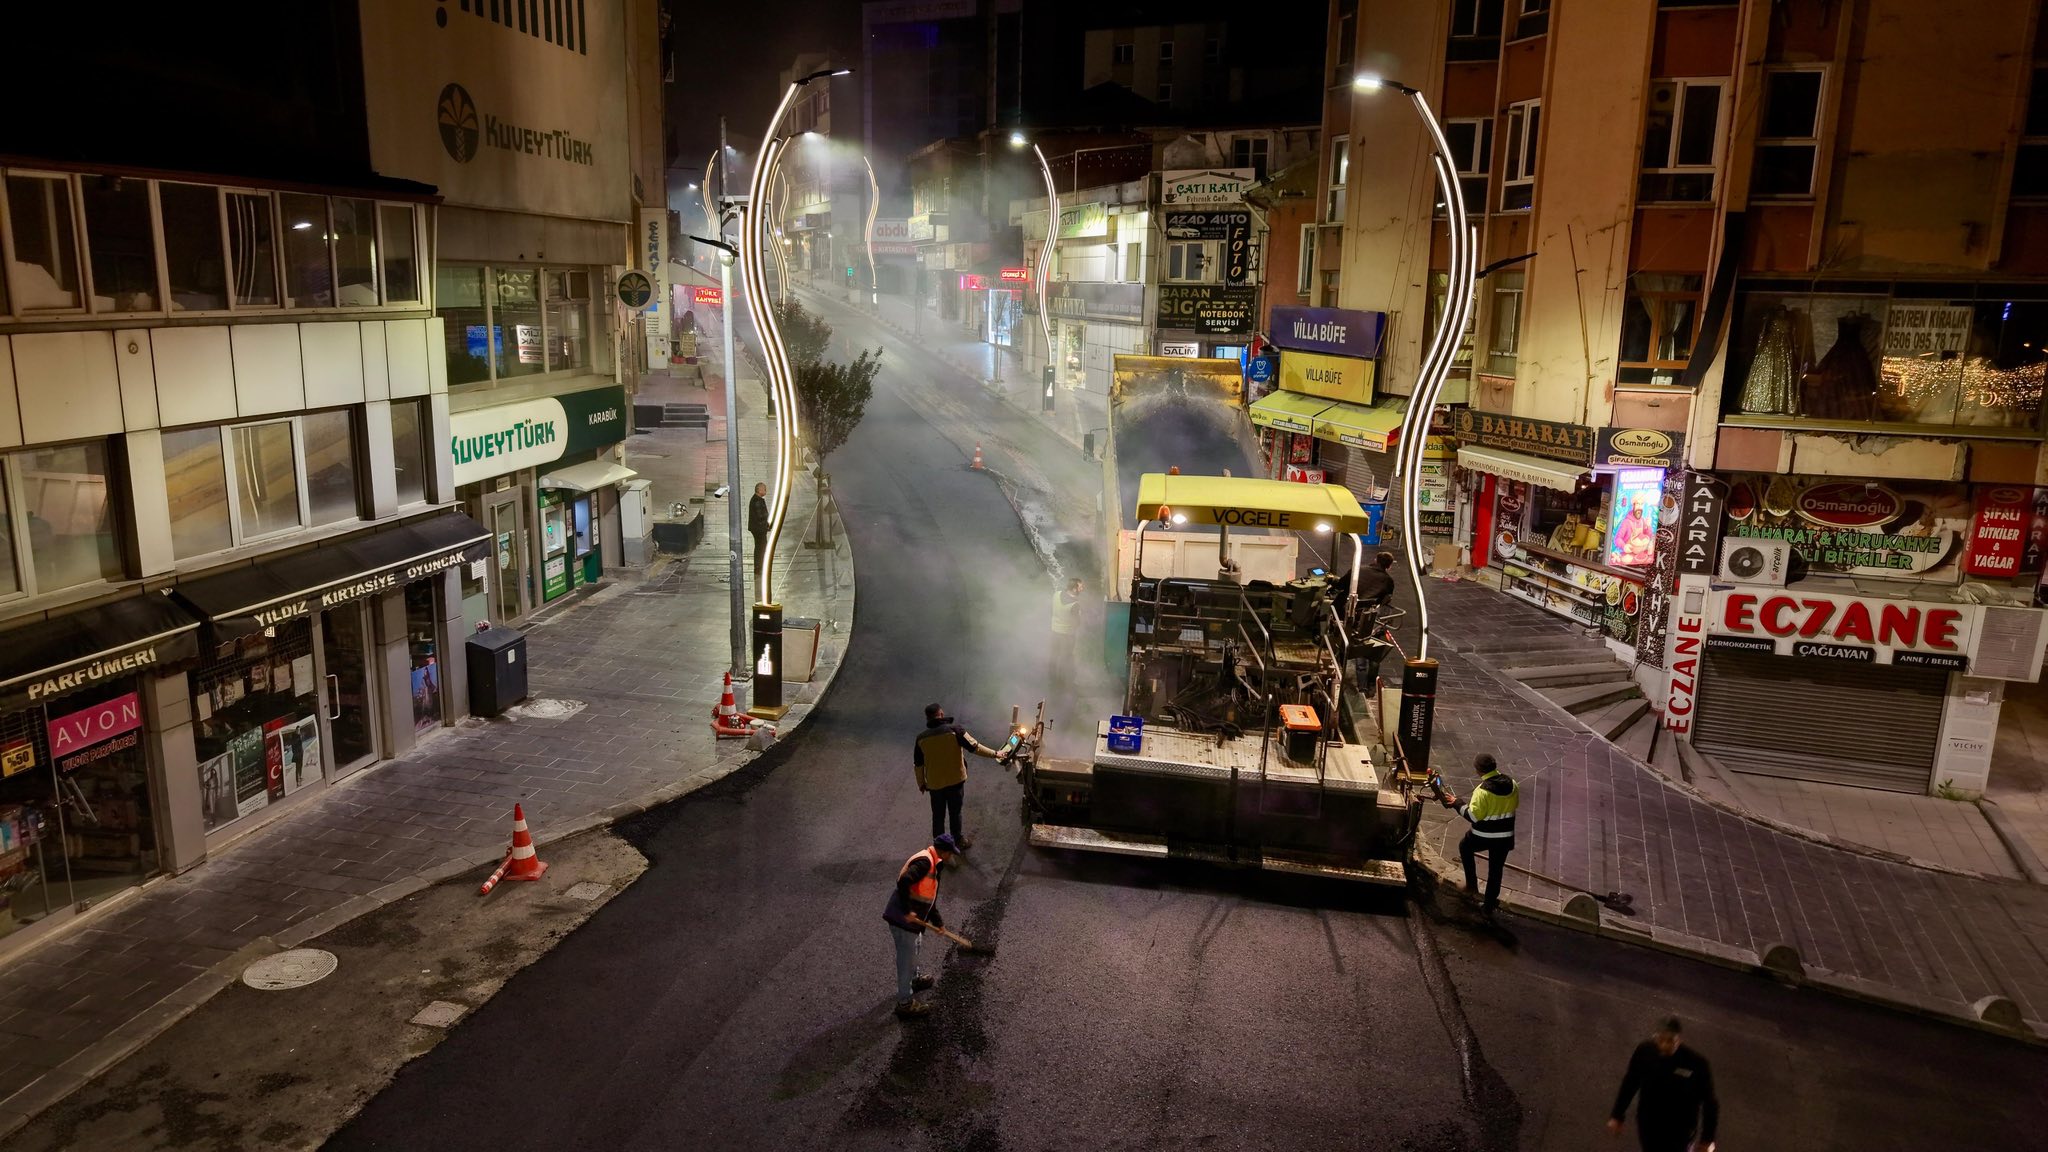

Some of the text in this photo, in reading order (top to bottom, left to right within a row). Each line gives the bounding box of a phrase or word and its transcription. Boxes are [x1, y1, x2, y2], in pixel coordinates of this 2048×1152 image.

[1176, 182, 1239, 196] ÇATI KATI
[1169, 214, 1247, 225] AZAD AUTO
[1230, 227, 1245, 278] FOTO
[1161, 288, 1211, 298] BARAN
[1200, 310, 1245, 318] NOTEBOOK
[1205, 318, 1240, 326] SERVİSİ
[1888, 309, 1928, 328] DEVREN
[1293, 318, 1347, 344] VİLLA BÜFE
[1887, 331, 1962, 350] 0506 095 78 77
[1305, 365, 1343, 385] VİLLA BÜFE
[588, 408, 618, 426] KARABÜK
[1482, 416, 1587, 448] BAHARAT
[1424, 441, 1444, 451] ddaa
[1618, 438, 1664, 450] Osmanoğlu
[1803, 498, 1892, 516] Osmanoğlu
[1212, 507, 1290, 527] VÖGELE
[1978, 523, 2020, 541] BİTKİLER
[2026, 493, 2048, 565] AHARAT
[1738, 525, 1814, 545] BAHARAT
[1820, 531, 1832, 546] &
[1835, 530, 1942, 554] KURUKAHVE
[1993, 542, 2000, 551] &
[407, 551, 467, 579] OYUNCAK
[1771, 546, 1783, 574] arçelik
[1824, 547, 1913, 570] BİTKİLER
[1974, 552, 2015, 570] YAĞLAR
[321, 573, 397, 607] KIRTASİYE
[253, 600, 309, 628] YILDIZ
[1723, 593, 1963, 652] ECZANE
[1707, 639, 1772, 651] DERMOKOZMETİK
[1799, 643, 1869, 661] ÇAĞLAYAN
[1900, 654, 1924, 664] ANNE
[1930, 657, 1960, 667] BEBEK
[28, 645, 157, 700] PARFÜMERİ
[1666, 616, 1702, 734] ECZANE
[56, 701, 138, 748] AVON
[1410, 703, 1421, 738] KARABÜK
[1953, 742, 1984, 750] VICHY
